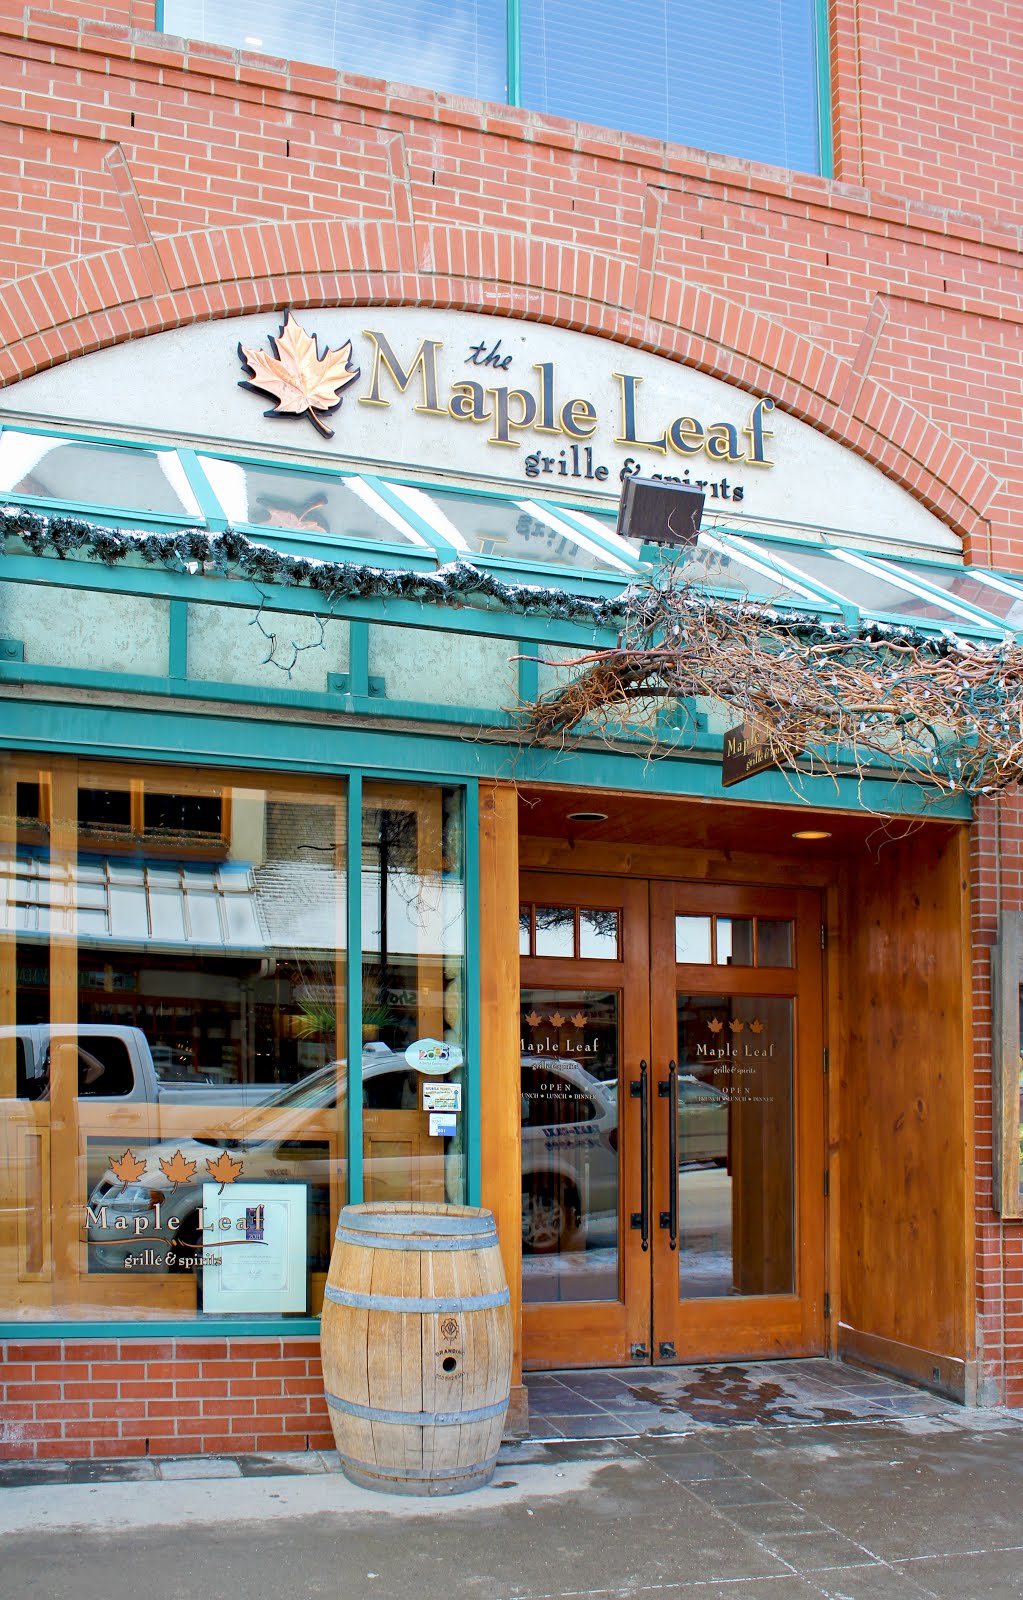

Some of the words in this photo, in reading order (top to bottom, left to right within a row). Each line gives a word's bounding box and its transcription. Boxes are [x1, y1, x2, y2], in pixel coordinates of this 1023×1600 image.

[464, 339, 513, 371] the
[357, 329, 599, 448] Maple
[613, 372, 775, 468] Leaf
[524, 444, 609, 482] grille
[727, 724, 760, 757] Maple
[566, 1038, 599, 1053] Leaf
[696, 1043, 738, 1059] Maple
[745, 1044, 775, 1057] Leaf
[713, 1065, 730, 1075] grille
[737, 1067, 756, 1075] spirits
[540, 1083, 571, 1091] OPEN
[83, 1202, 180, 1235] Maple
[195, 1203, 266, 1232] Leaf
[124, 1250, 163, 1269] grille
[165, 1252, 177, 1266] &
[178, 1252, 223, 1269] spirits
